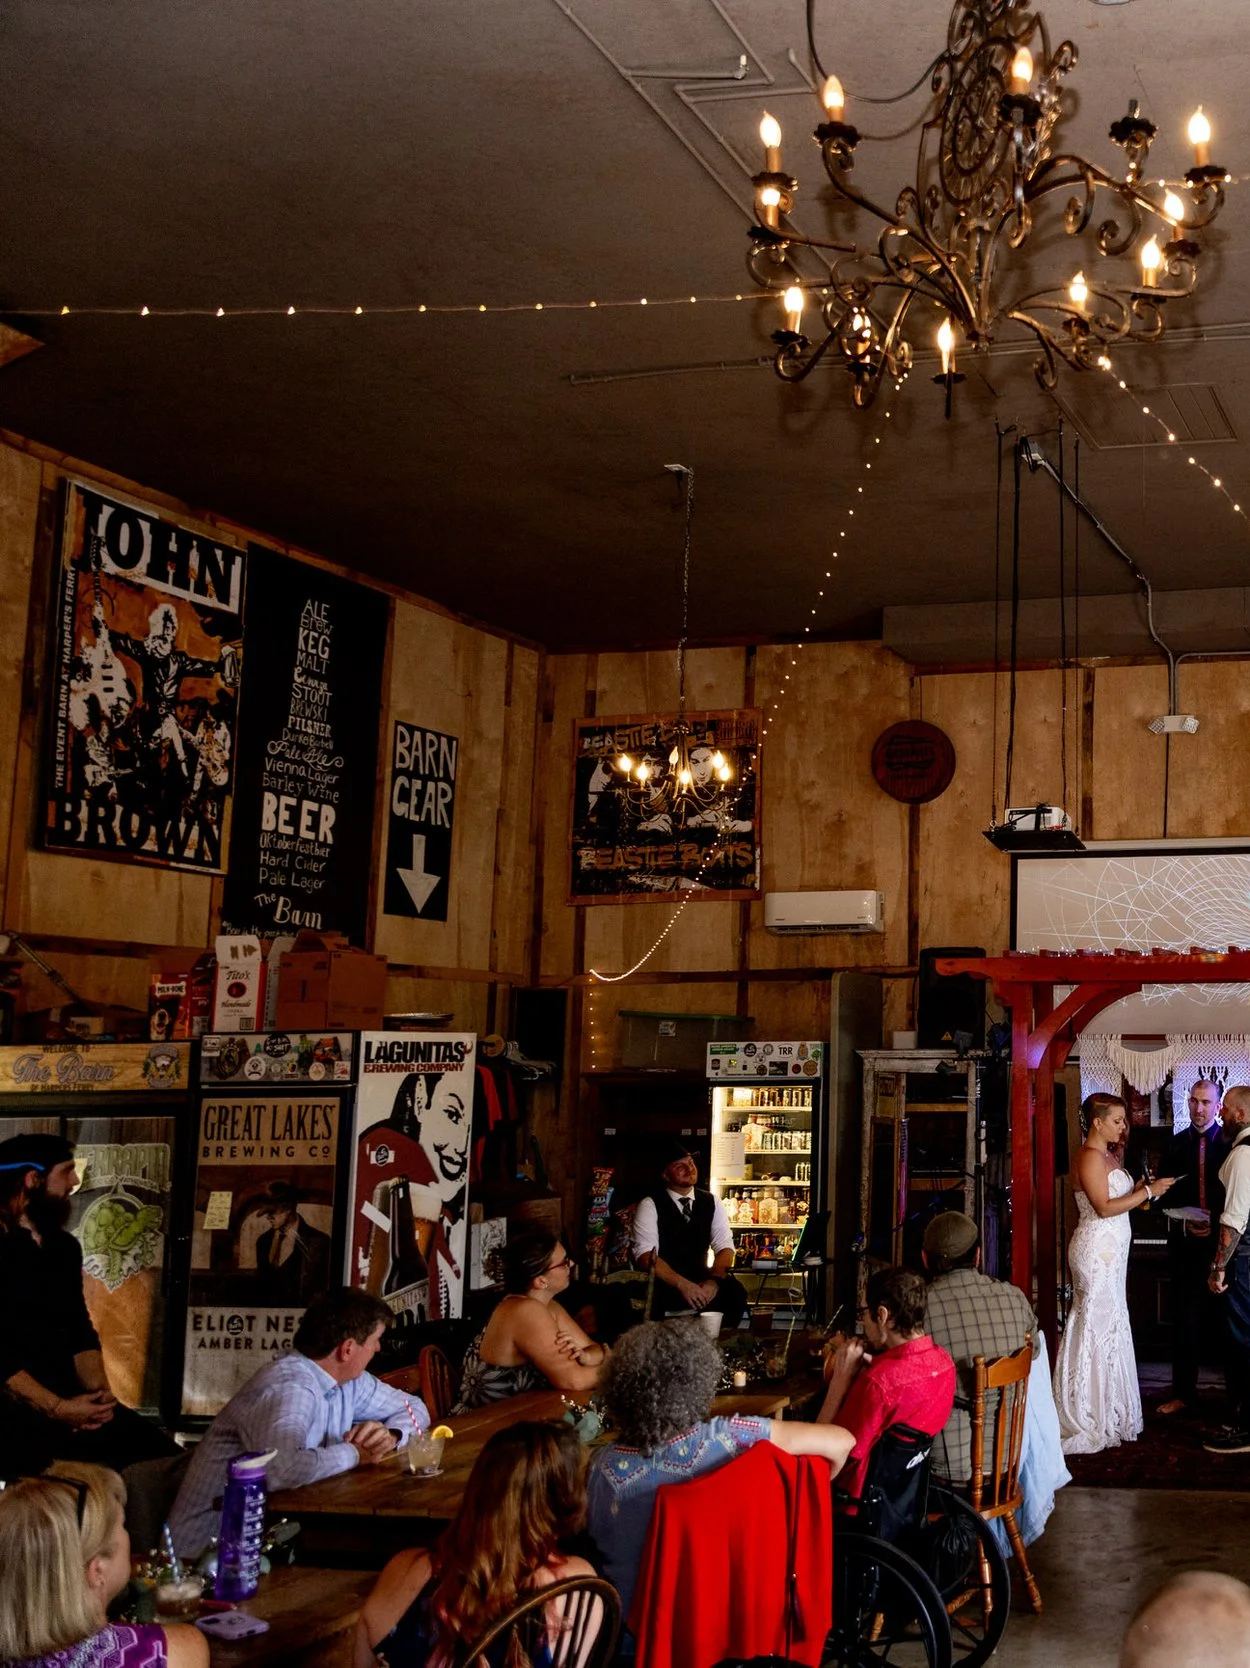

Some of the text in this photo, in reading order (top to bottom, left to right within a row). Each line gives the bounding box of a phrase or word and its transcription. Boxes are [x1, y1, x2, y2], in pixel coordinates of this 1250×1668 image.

[72, 492, 241, 608] JOHN
[66, 567, 77, 602] FERRY
[301, 598, 331, 624] ALE
[62, 605, 75, 664] HARPER'S
[298, 626, 331, 659] KEG
[296, 650, 331, 675] MALT
[58, 684, 71, 717] BARN
[291, 683, 333, 707] STOUT
[289, 698, 328, 722] BREWSKI
[56, 719, 68, 760] EVENT
[287, 715, 332, 738] PILSNER
[395, 724, 457, 781] BARN
[55, 763, 66, 789] THE
[264, 756, 339, 788] Vienna Lager
[262, 772, 340, 803] Barley Wine
[392, 775, 454, 829] GEAR
[261, 791, 336, 845] BEER
[55, 797, 221, 867] BROWN
[260, 850, 327, 873] Hard Cider
[577, 843, 678, 872] BEASTIE
[259, 868, 326, 895] Pale Lager
[254, 892, 322, 930] The Barn
[226, 970, 251, 980] Tito's
[42, 1044, 91, 1053] WELCOME TO
[364, 1041, 465, 1063] LAGUNITAS
[778, 1046, 793, 1055] TRR
[12, 1052, 114, 1084] The Barn
[363, 1063, 465, 1073] BREWING COMPANY
[73, 1083, 94, 1091] FERRY
[204, 1104, 336, 1141] GREAT LAKES
[203, 1145, 296, 1158] BREWING
[192, 1314, 257, 1336] ELIT
[198, 1338, 253, 1350] AMBER
